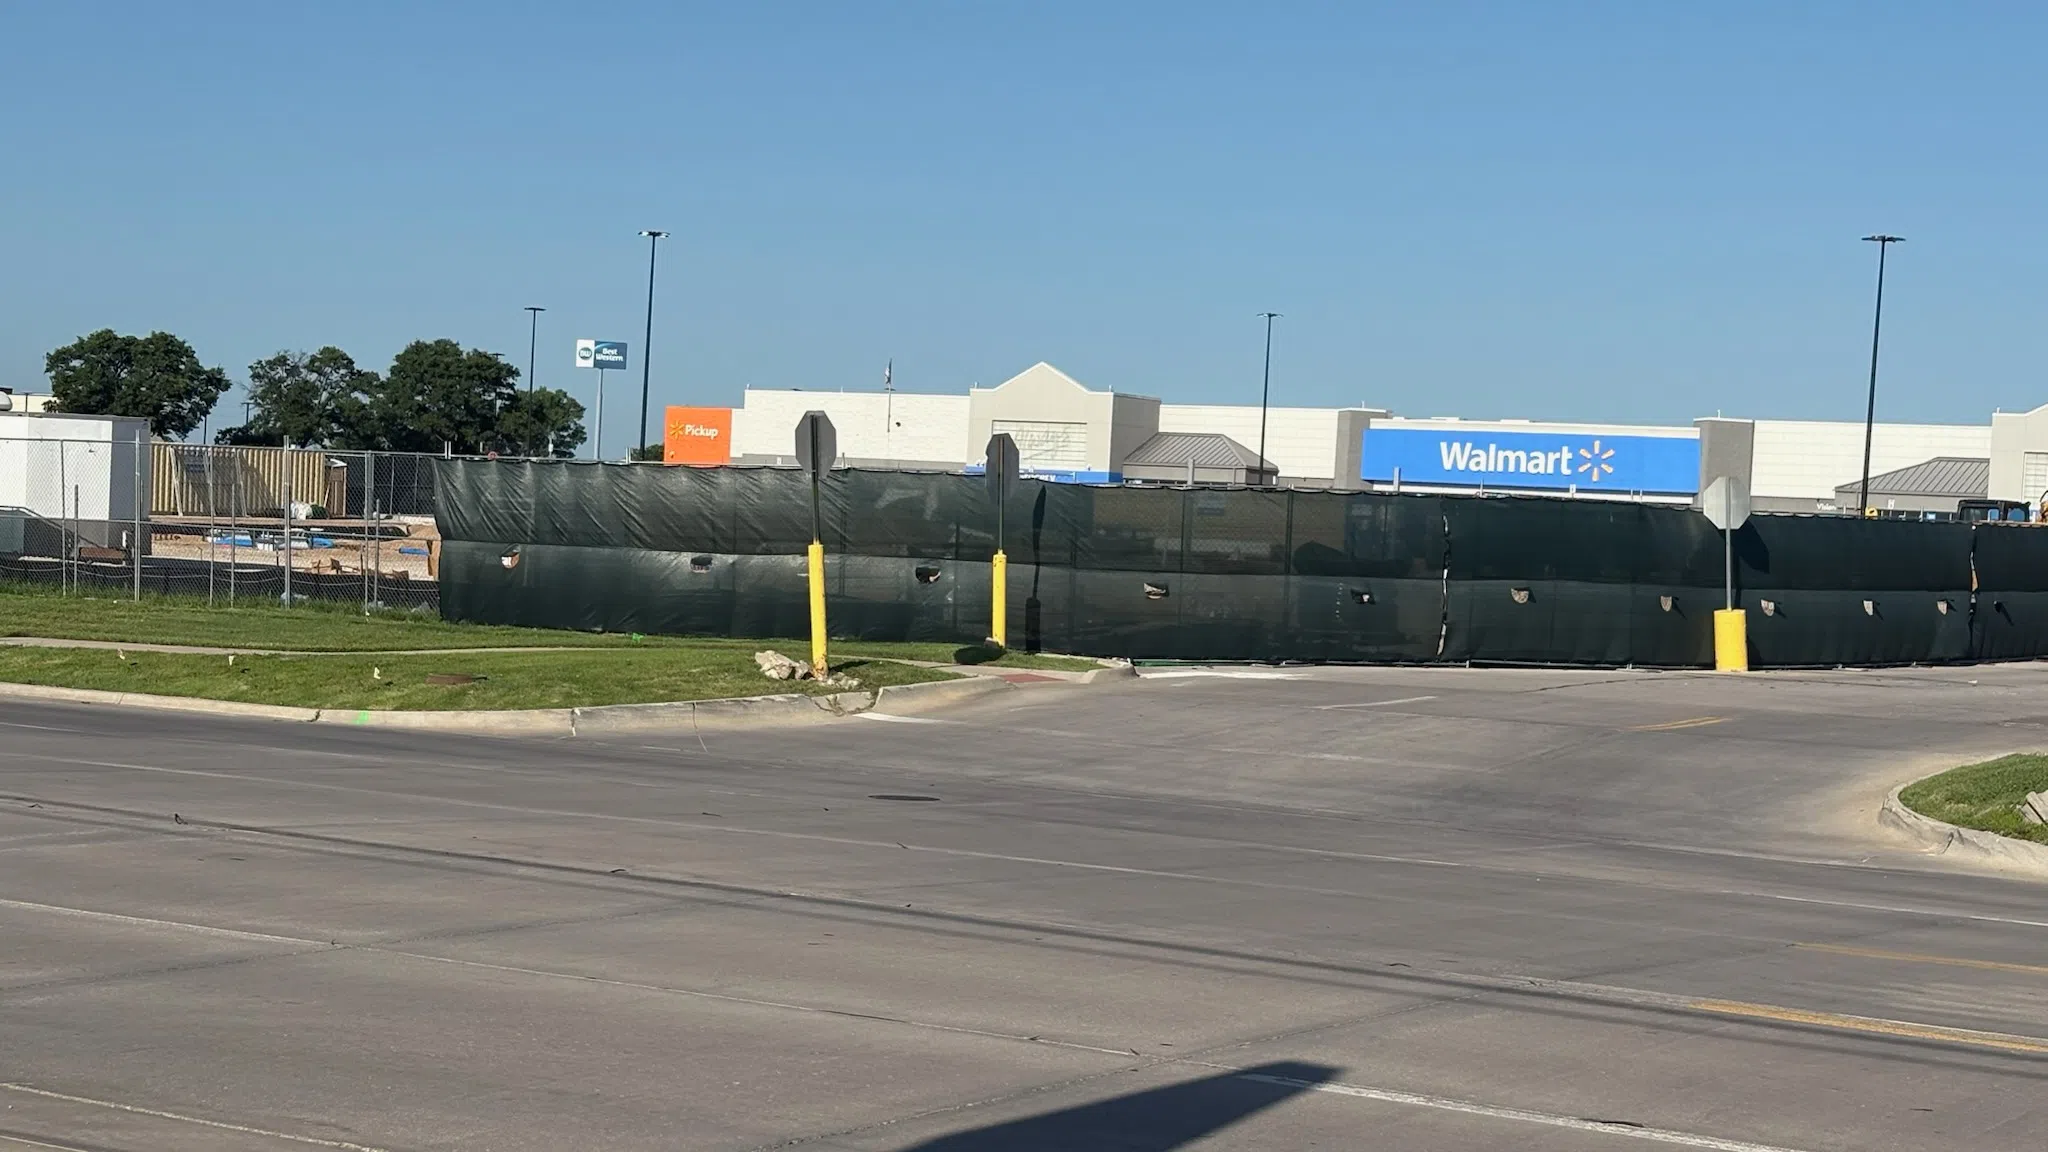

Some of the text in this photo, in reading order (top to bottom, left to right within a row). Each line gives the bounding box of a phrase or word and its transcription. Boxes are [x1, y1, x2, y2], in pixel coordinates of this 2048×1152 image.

[595, 353, 624, 361] Western
[602, 347, 618, 355] Best
[684, 424, 719, 440] Pickup
[1439, 441, 1573, 476] Walmart
